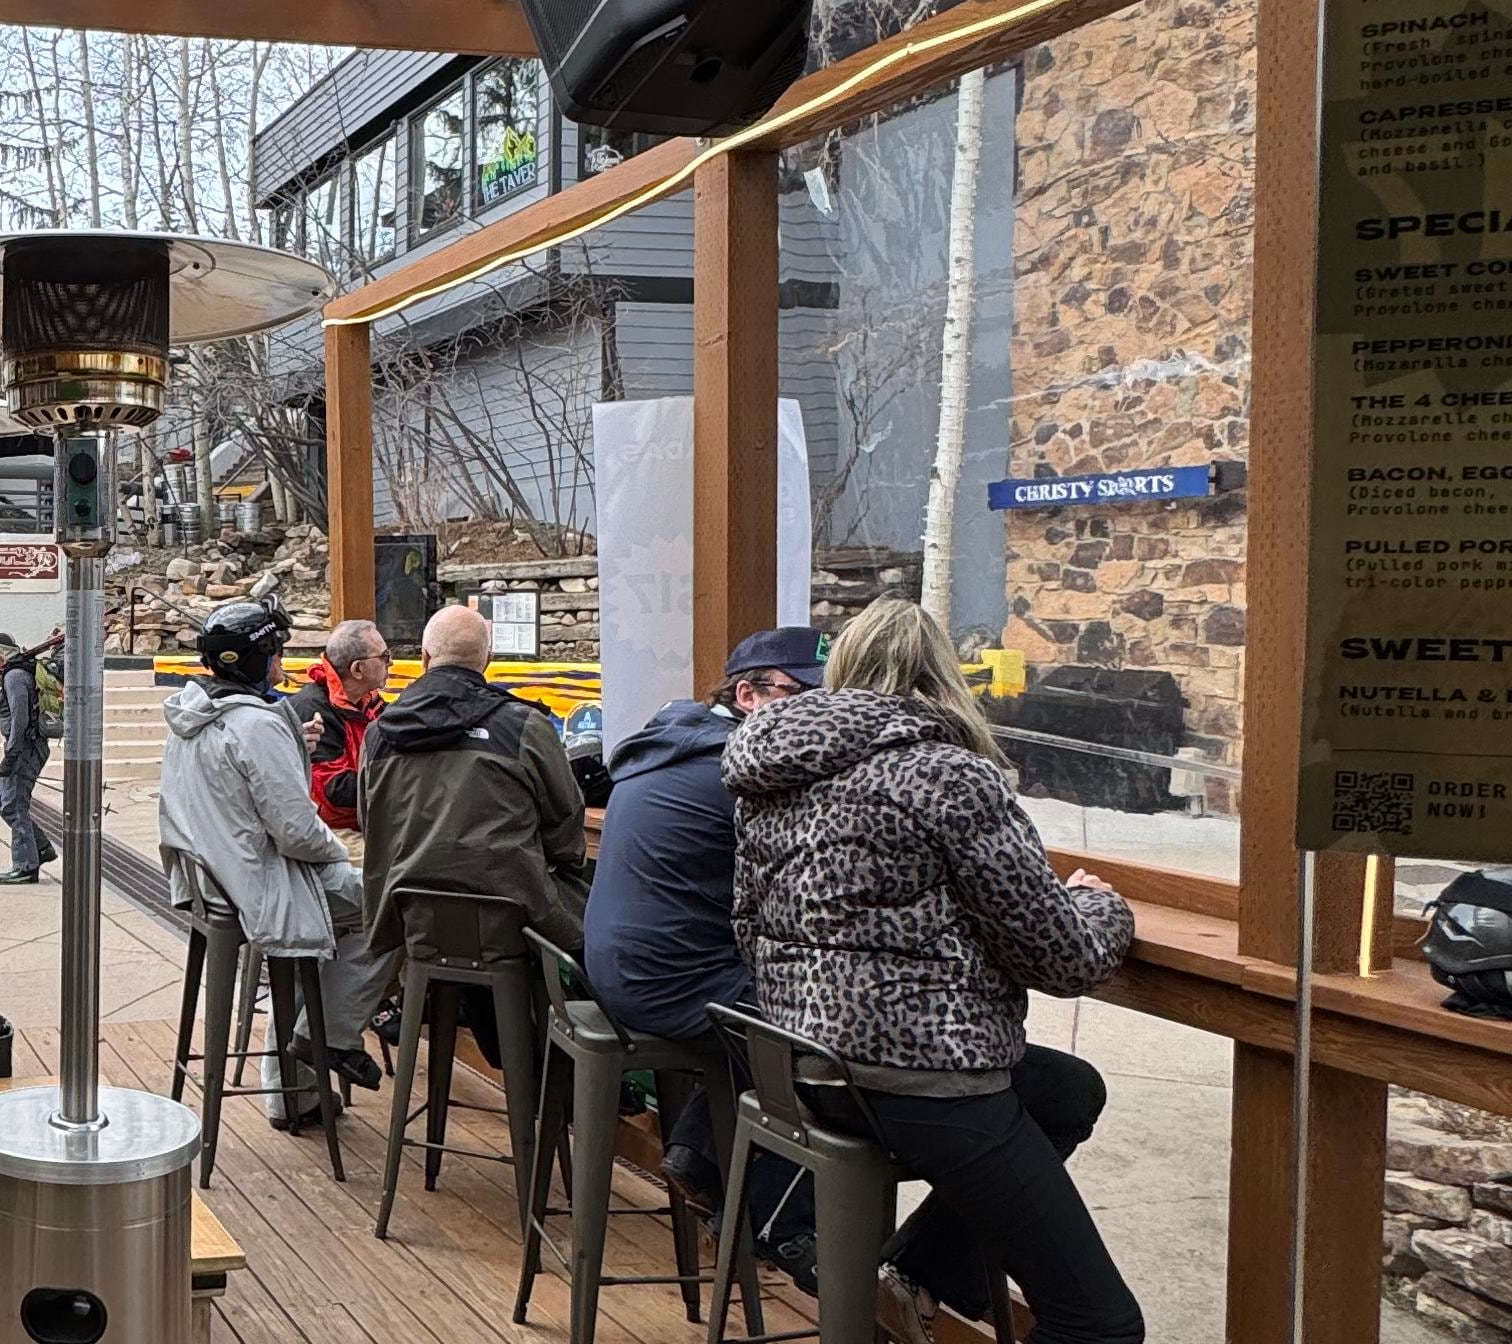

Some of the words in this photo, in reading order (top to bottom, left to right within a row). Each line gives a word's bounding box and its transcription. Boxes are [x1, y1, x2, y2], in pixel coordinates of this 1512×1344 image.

[1361, 12, 1489, 38] SPINACH
[1363, 39, 1430, 57] (Fresh
[1361, 51, 1465, 72] Provolone
[1360, 65, 1490, 91] hard-boiled
[1361, 118, 1488, 143] (Mozzarella
[1358, 141, 1428, 160] cheese
[1441, 137, 1477, 153] and
[1357, 162, 1392, 177] and
[1354, 263, 1458, 283] SWEET
[1355, 284, 1436, 301] (Grated
[1449, 278, 1507, 296] sweet
[1353, 300, 1458, 318] Provolone
[1351, 395, 1405, 410] THE
[1414, 394, 1433, 408] 4
[1352, 412, 1478, 429] (Mozzarella
[1350, 429, 1453, 444] Provolone
[1348, 466, 1454, 482] BACON,
[1014, 480, 1095, 503] CHRISTY
[1097, 474, 1176, 498] SPORTS
[1349, 485, 1416, 501] (Diced
[1429, 485, 1495, 500] bacon,
[1348, 502, 1449, 517] Provolone
[1345, 540, 1450, 555] PULLED
[1346, 557, 1424, 573] (Pulled
[1437, 558, 1483, 574] pork
[1345, 574, 1447, 590] tri-color
[248, 620, 277, 642] SMITH
[1339, 686, 1469, 702] NUTELLA
[1477, 688, 1497, 703] &
[1340, 702, 1431, 718] (Nutella
[1444, 707, 1479, 721] and
[1428, 780, 1507, 799] ORDER
[1428, 802, 1487, 820] NOW!
